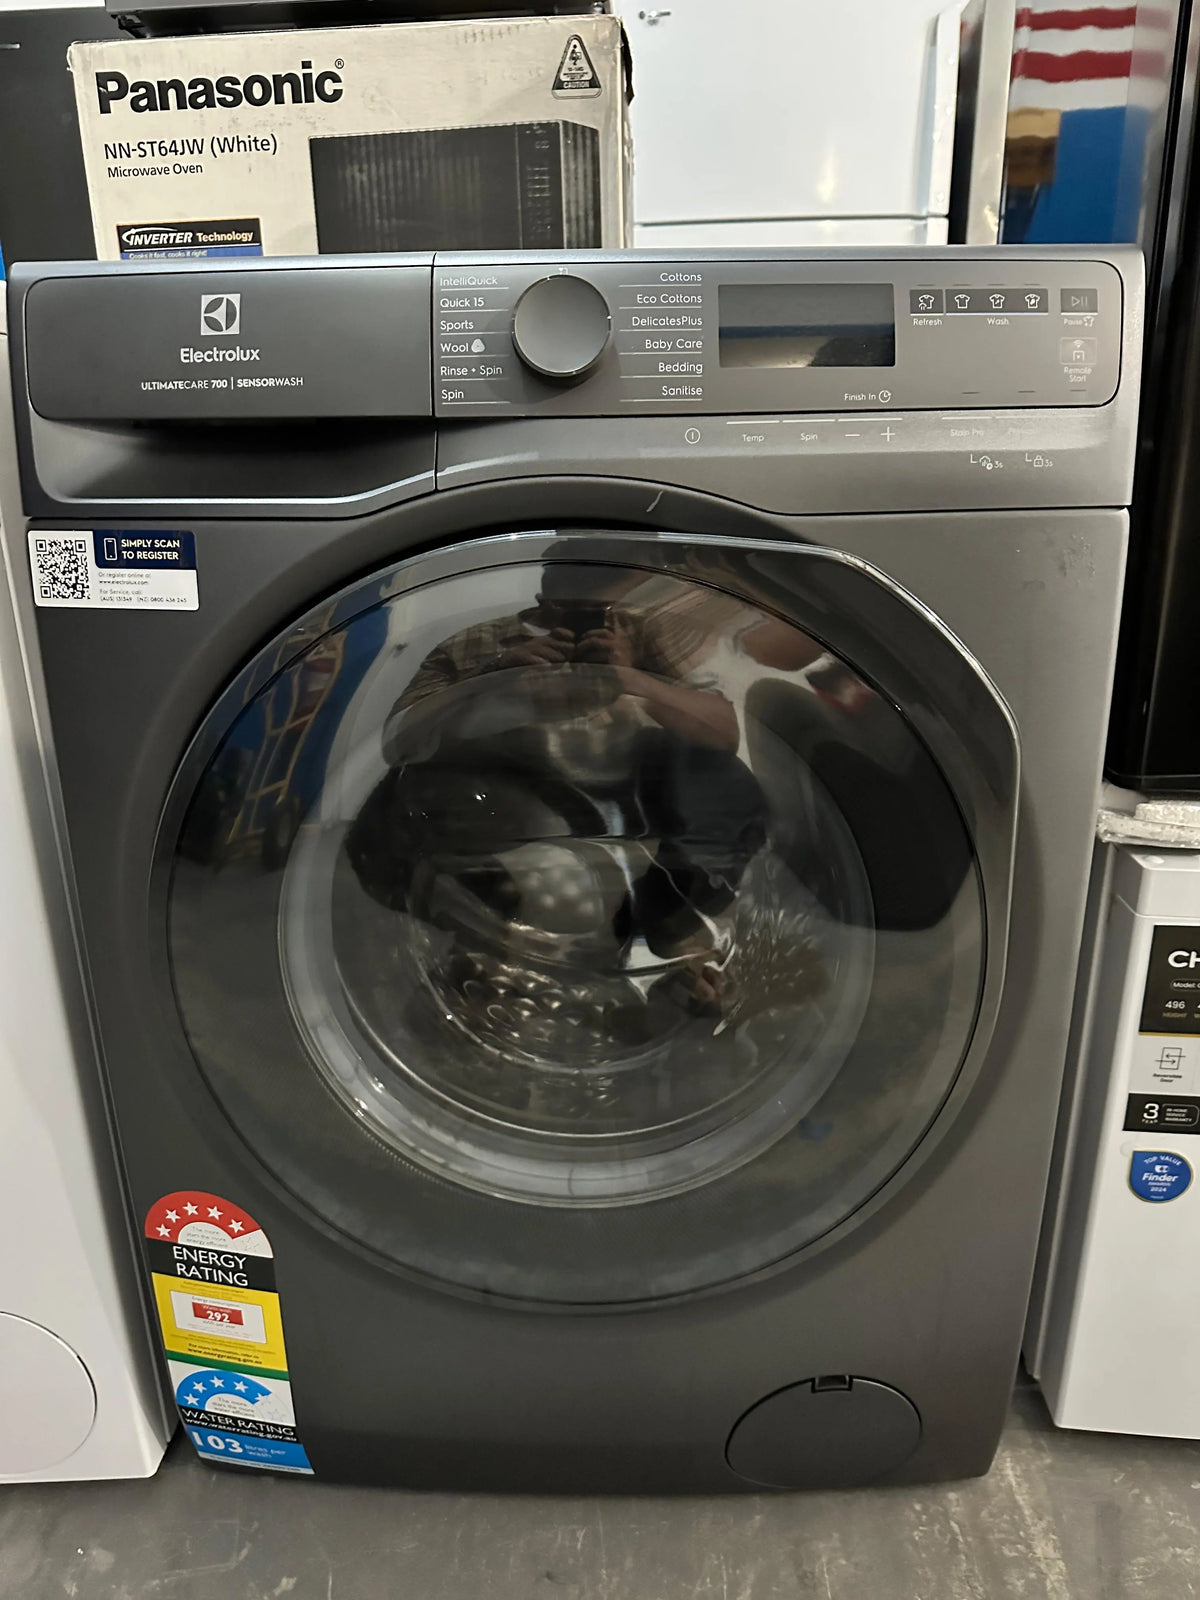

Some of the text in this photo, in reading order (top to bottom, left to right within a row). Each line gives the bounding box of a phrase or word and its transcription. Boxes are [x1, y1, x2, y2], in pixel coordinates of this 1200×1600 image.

[95, 60, 344, 115] Panasonic
[104, 133, 278, 160] NN-ST64JW (White)
[107, 163, 203, 178] Microwave Oven
[129, 231, 253, 246] INVERTER Technology
[440, 275, 498, 287] IntelliQuick
[660, 272, 702, 282] Cottons
[440, 297, 485, 308] Quick 15
[637, 293, 702, 304] Eco Cottons
[440, 320, 473, 331] Sports
[632, 316, 702, 327] DelicatesPlus
[913, 318, 942, 326] Refresh
[987, 317, 1009, 326] Wash
[440, 342, 468, 353] Wool
[645, 338, 703, 350] Baby Care
[180, 346, 260, 363] Electrolux
[440, 365, 468, 376] Rinse
[479, 365, 502, 377] Spin
[658, 362, 703, 374] Bedding
[1063, 366, 1092, 375] Remote
[1069, 374, 1086, 382] Start
[141, 377, 304, 391] ULTIMATECARE 700 SENSORWASH
[441, 389, 464, 400] Spin
[661, 385, 703, 396] Sanitise
[844, 393, 866, 401] Finish
[742, 434, 764, 442] Temp
[800, 432, 818, 441] Spin
[121, 539, 180, 548] SIMPLY SCAN
[121, 551, 179, 560] TO REGISTER
[1165, 1000, 1185, 1009] 496
[1143, 1103, 1159, 1119] 3
[1144, 1155, 1182, 1166] TOP VALUE
[1142, 1172, 1179, 1182] Finder
[172, 1245, 247, 1270] ENERGY
[176, 1262, 249, 1287] RATING
[206, 1310, 230, 1323] 292
[182, 1408, 295, 1437] WATER RATING
[191, 1431, 244, 1454] 103
